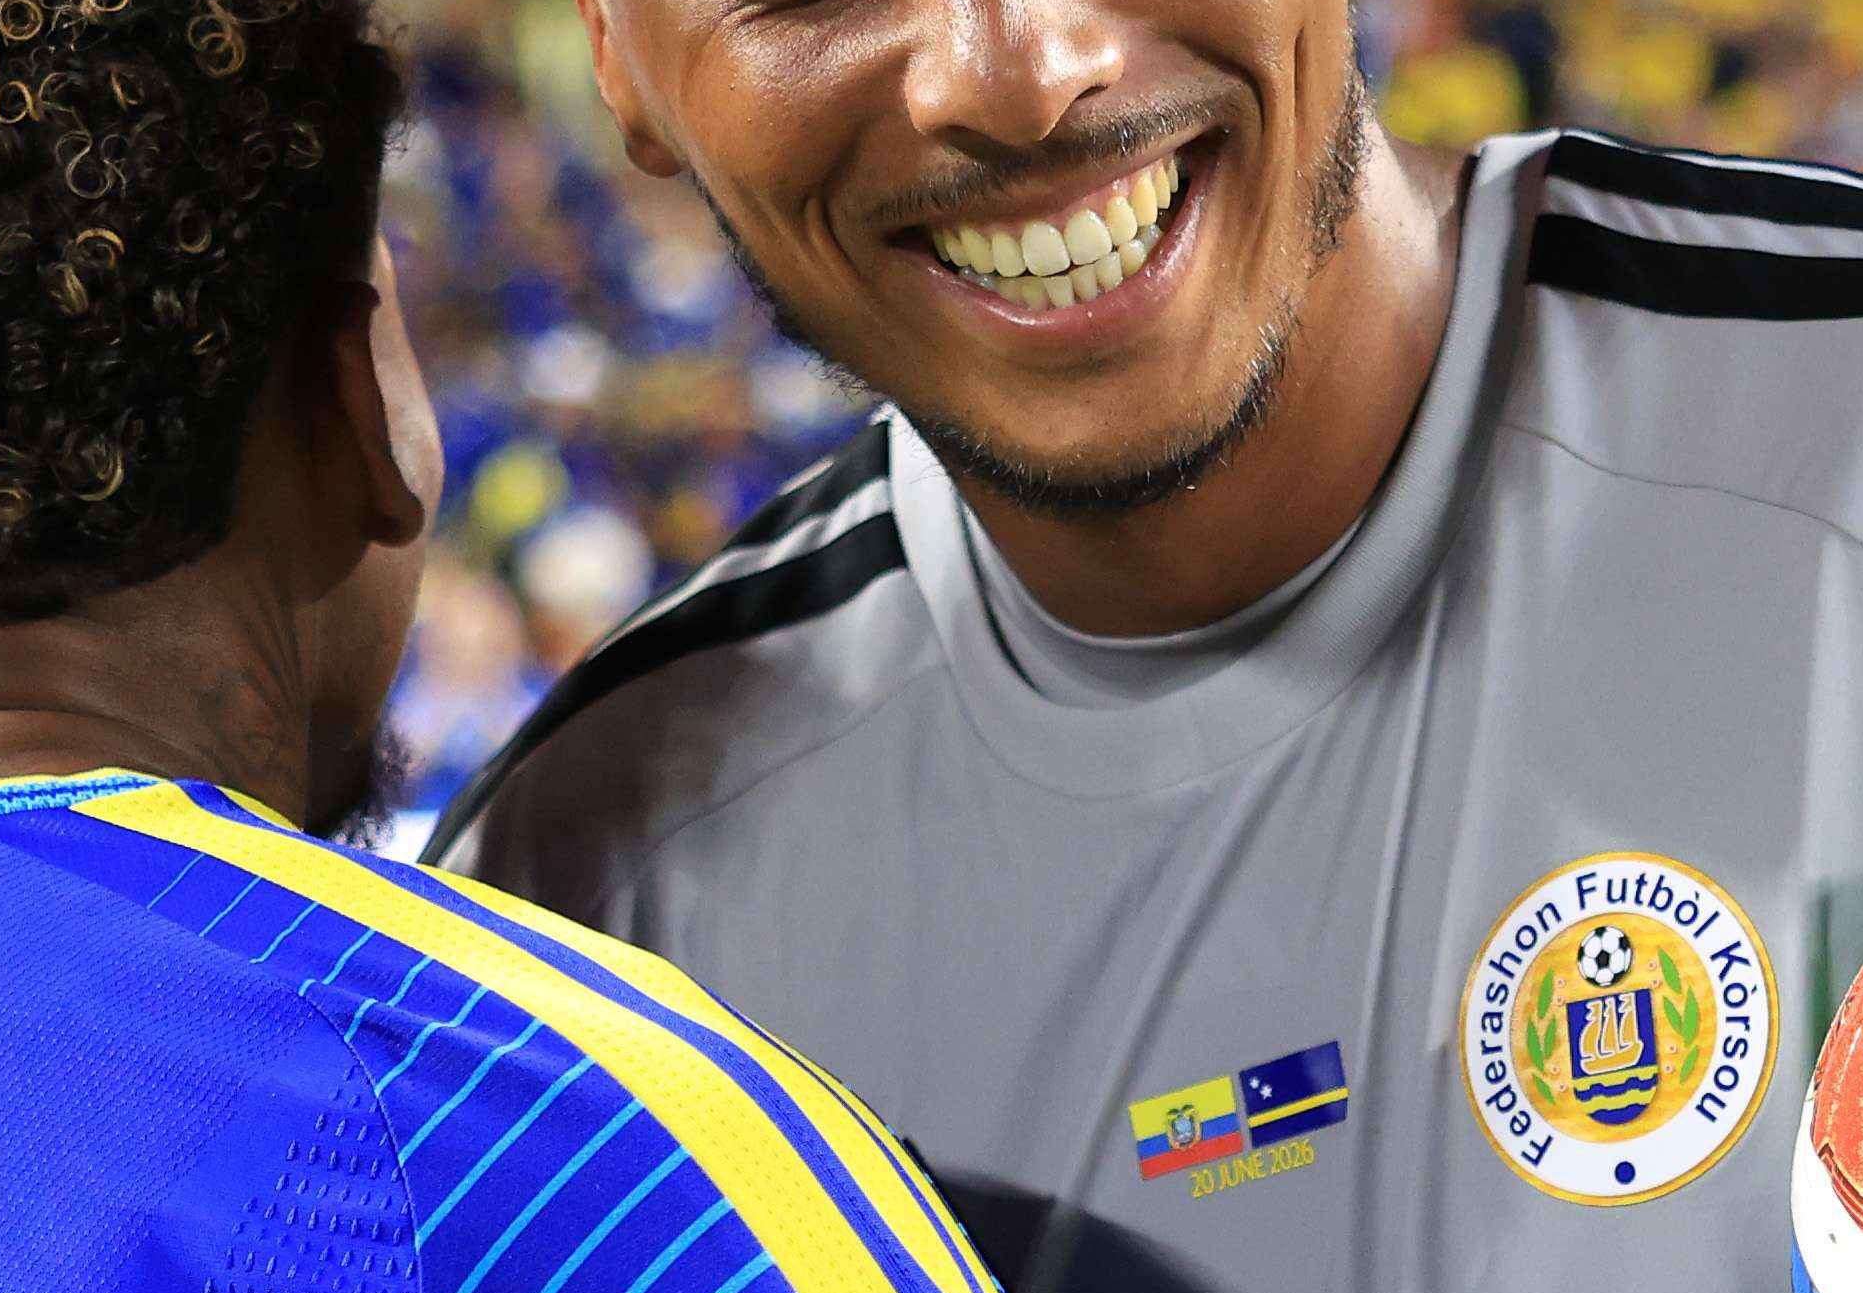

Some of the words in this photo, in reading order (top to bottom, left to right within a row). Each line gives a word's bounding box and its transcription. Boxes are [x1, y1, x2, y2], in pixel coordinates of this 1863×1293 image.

[1481, 901, 1563, 1167] Federashon
[1575, 872, 1720, 939] Futbòl
[1695, 940, 1758, 1124] Kòrsou
[1189, 1169, 1216, 1199] 20
[1219, 1151, 1267, 1191] JUNE
[1270, 1138, 1316, 1174] 2026
